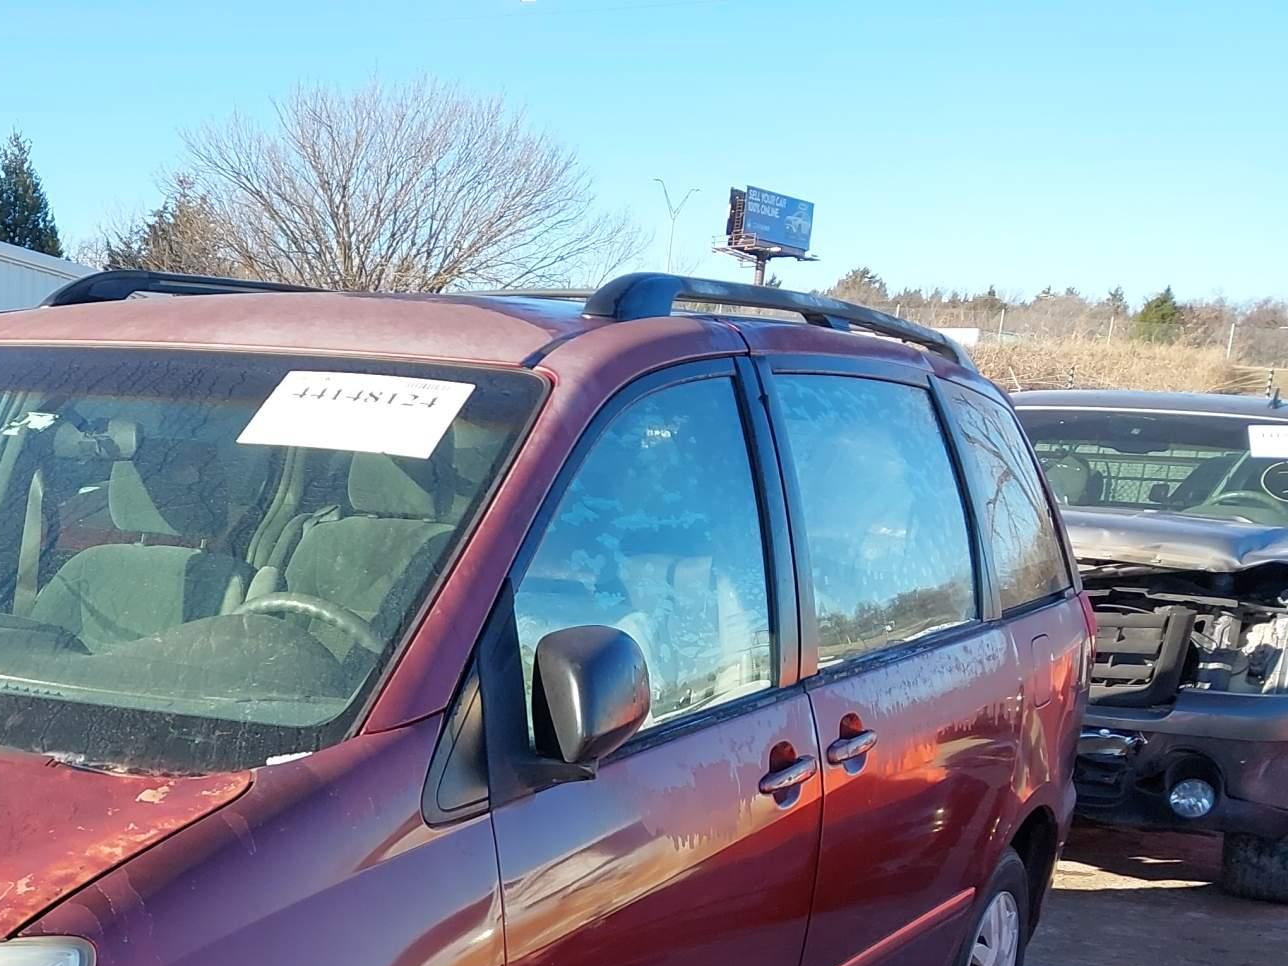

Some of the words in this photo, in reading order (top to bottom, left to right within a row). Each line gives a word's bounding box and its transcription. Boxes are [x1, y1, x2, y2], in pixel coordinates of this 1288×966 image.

[749, 189, 760, 201] SELL
[776, 197, 787, 208] CAR
[761, 204, 780, 218] ONLINE
[292, 386, 438, 408] 44148124
